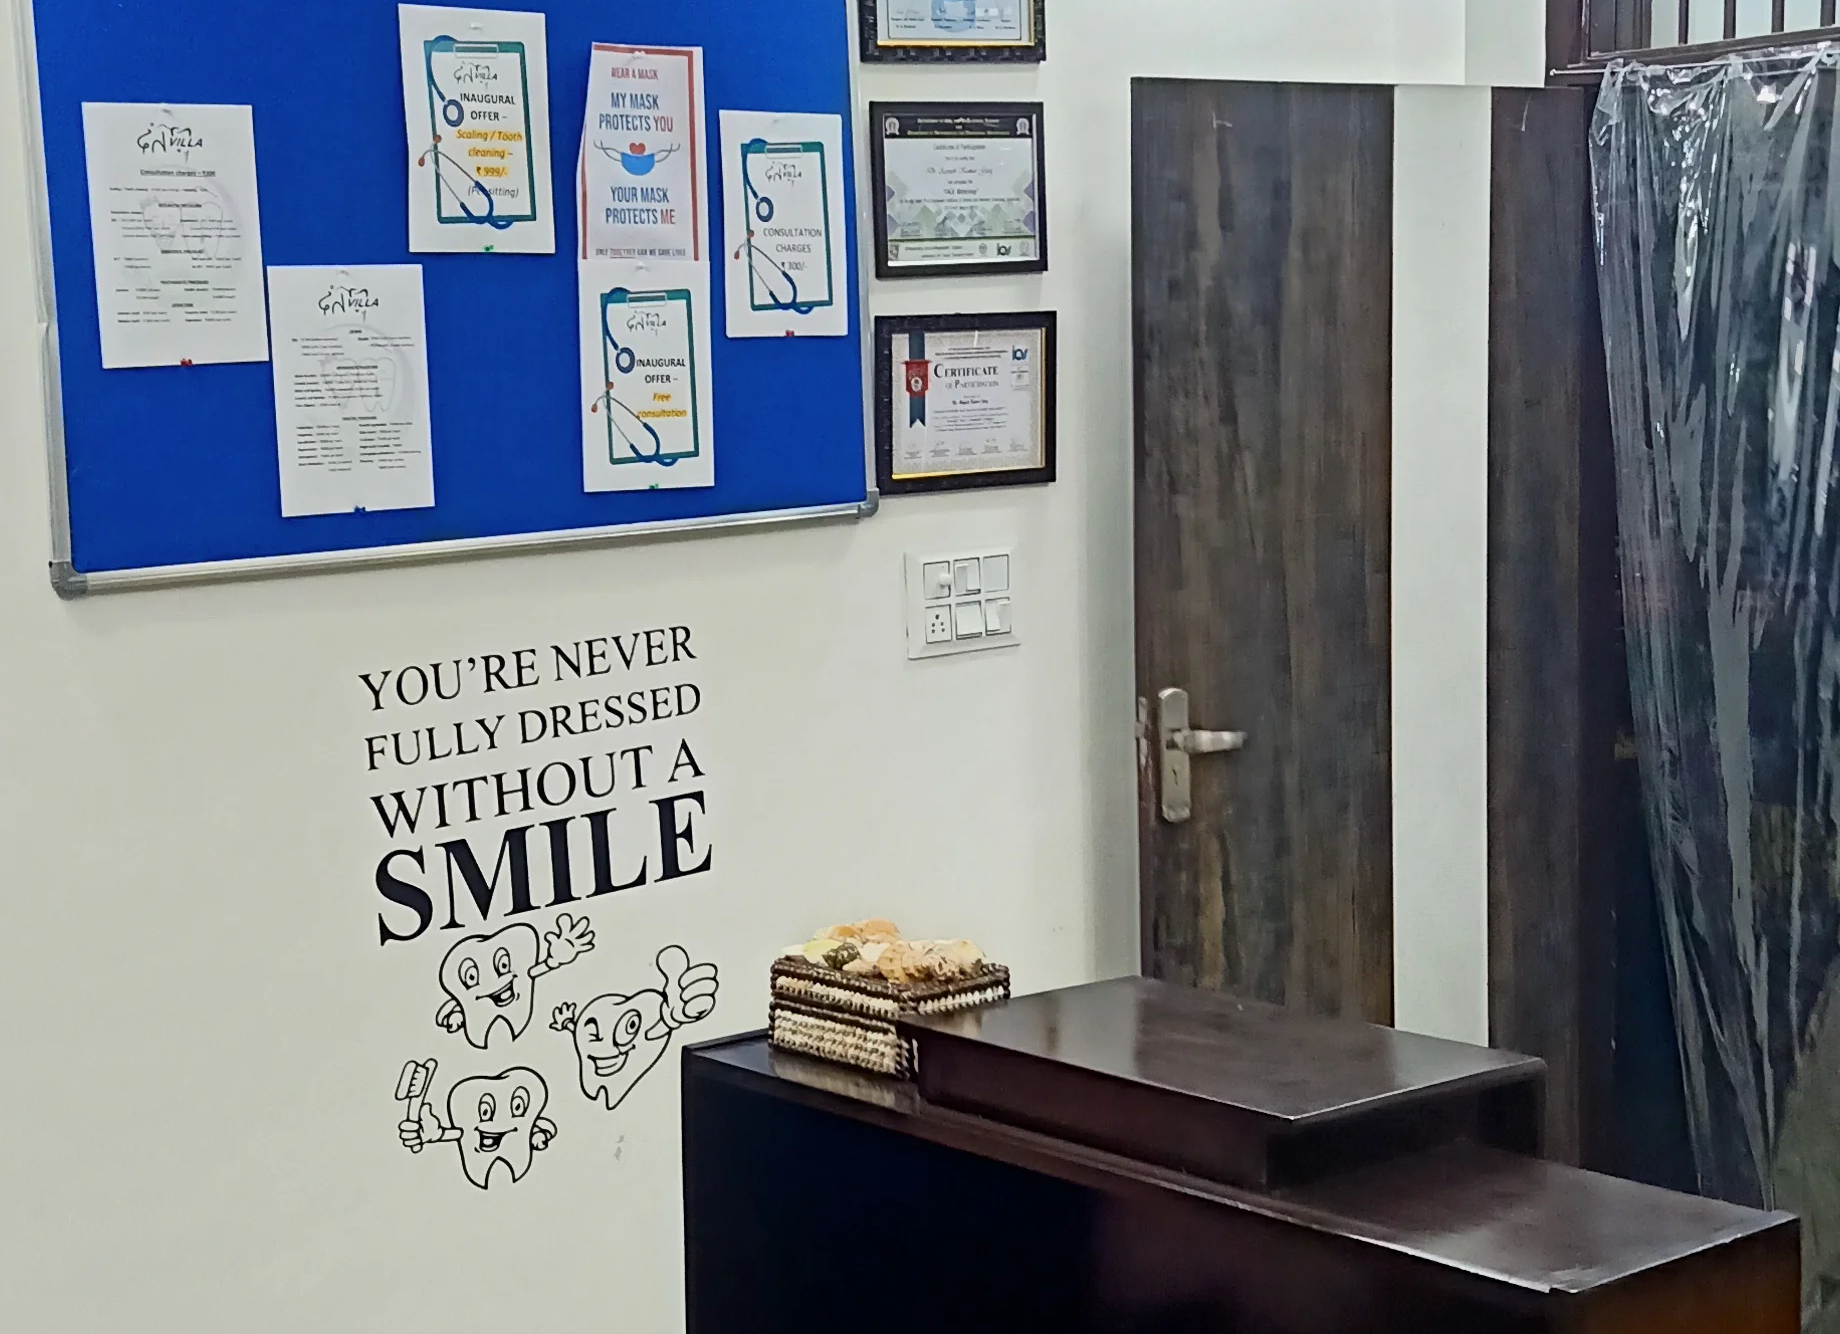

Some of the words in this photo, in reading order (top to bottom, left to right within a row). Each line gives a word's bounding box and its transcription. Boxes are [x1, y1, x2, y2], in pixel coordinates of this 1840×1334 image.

[611, 66, 630, 79] WEAR
[632, 68, 637, 79] A
[638, 68, 659, 80] MASK
[459, 92, 516, 106] INAUGURAL
[611, 91, 627, 109] MY
[629, 92, 660, 110] MASK
[470, 110, 500, 122] OFFER
[599, 113, 651, 132] PROTECTS
[653, 115, 674, 133] YOU
[170, 137, 203, 148] VILLA
[456, 129, 488, 142] Scaling
[497, 131, 523, 142] Tooth
[468, 147, 505, 160] cleaning
[610, 186, 638, 203] YOUR
[640, 186, 669, 203] MASK
[605, 207, 658, 224] PROTECTS
[660, 208, 676, 225] ME
[763, 227, 822, 238] CONSULTATION
[775, 243, 811, 254] CHARGES
[636, 358, 686, 368] INAUGURAL
[933, 363, 999, 379] CERTIFICATE
[644, 374, 671, 384] OFFER
[653, 392, 671, 402] Free
[638, 409, 688, 419] consultation
[358, 648, 540, 712] YOU'RE
[550, 625, 698, 683] NEVER
[364, 714, 506, 771] FULLY
[518, 683, 701, 745] DRESSED
[369, 744, 654, 839] WITHOUT
[667, 738, 706, 783] A
[375, 790, 712, 947] SMILE
